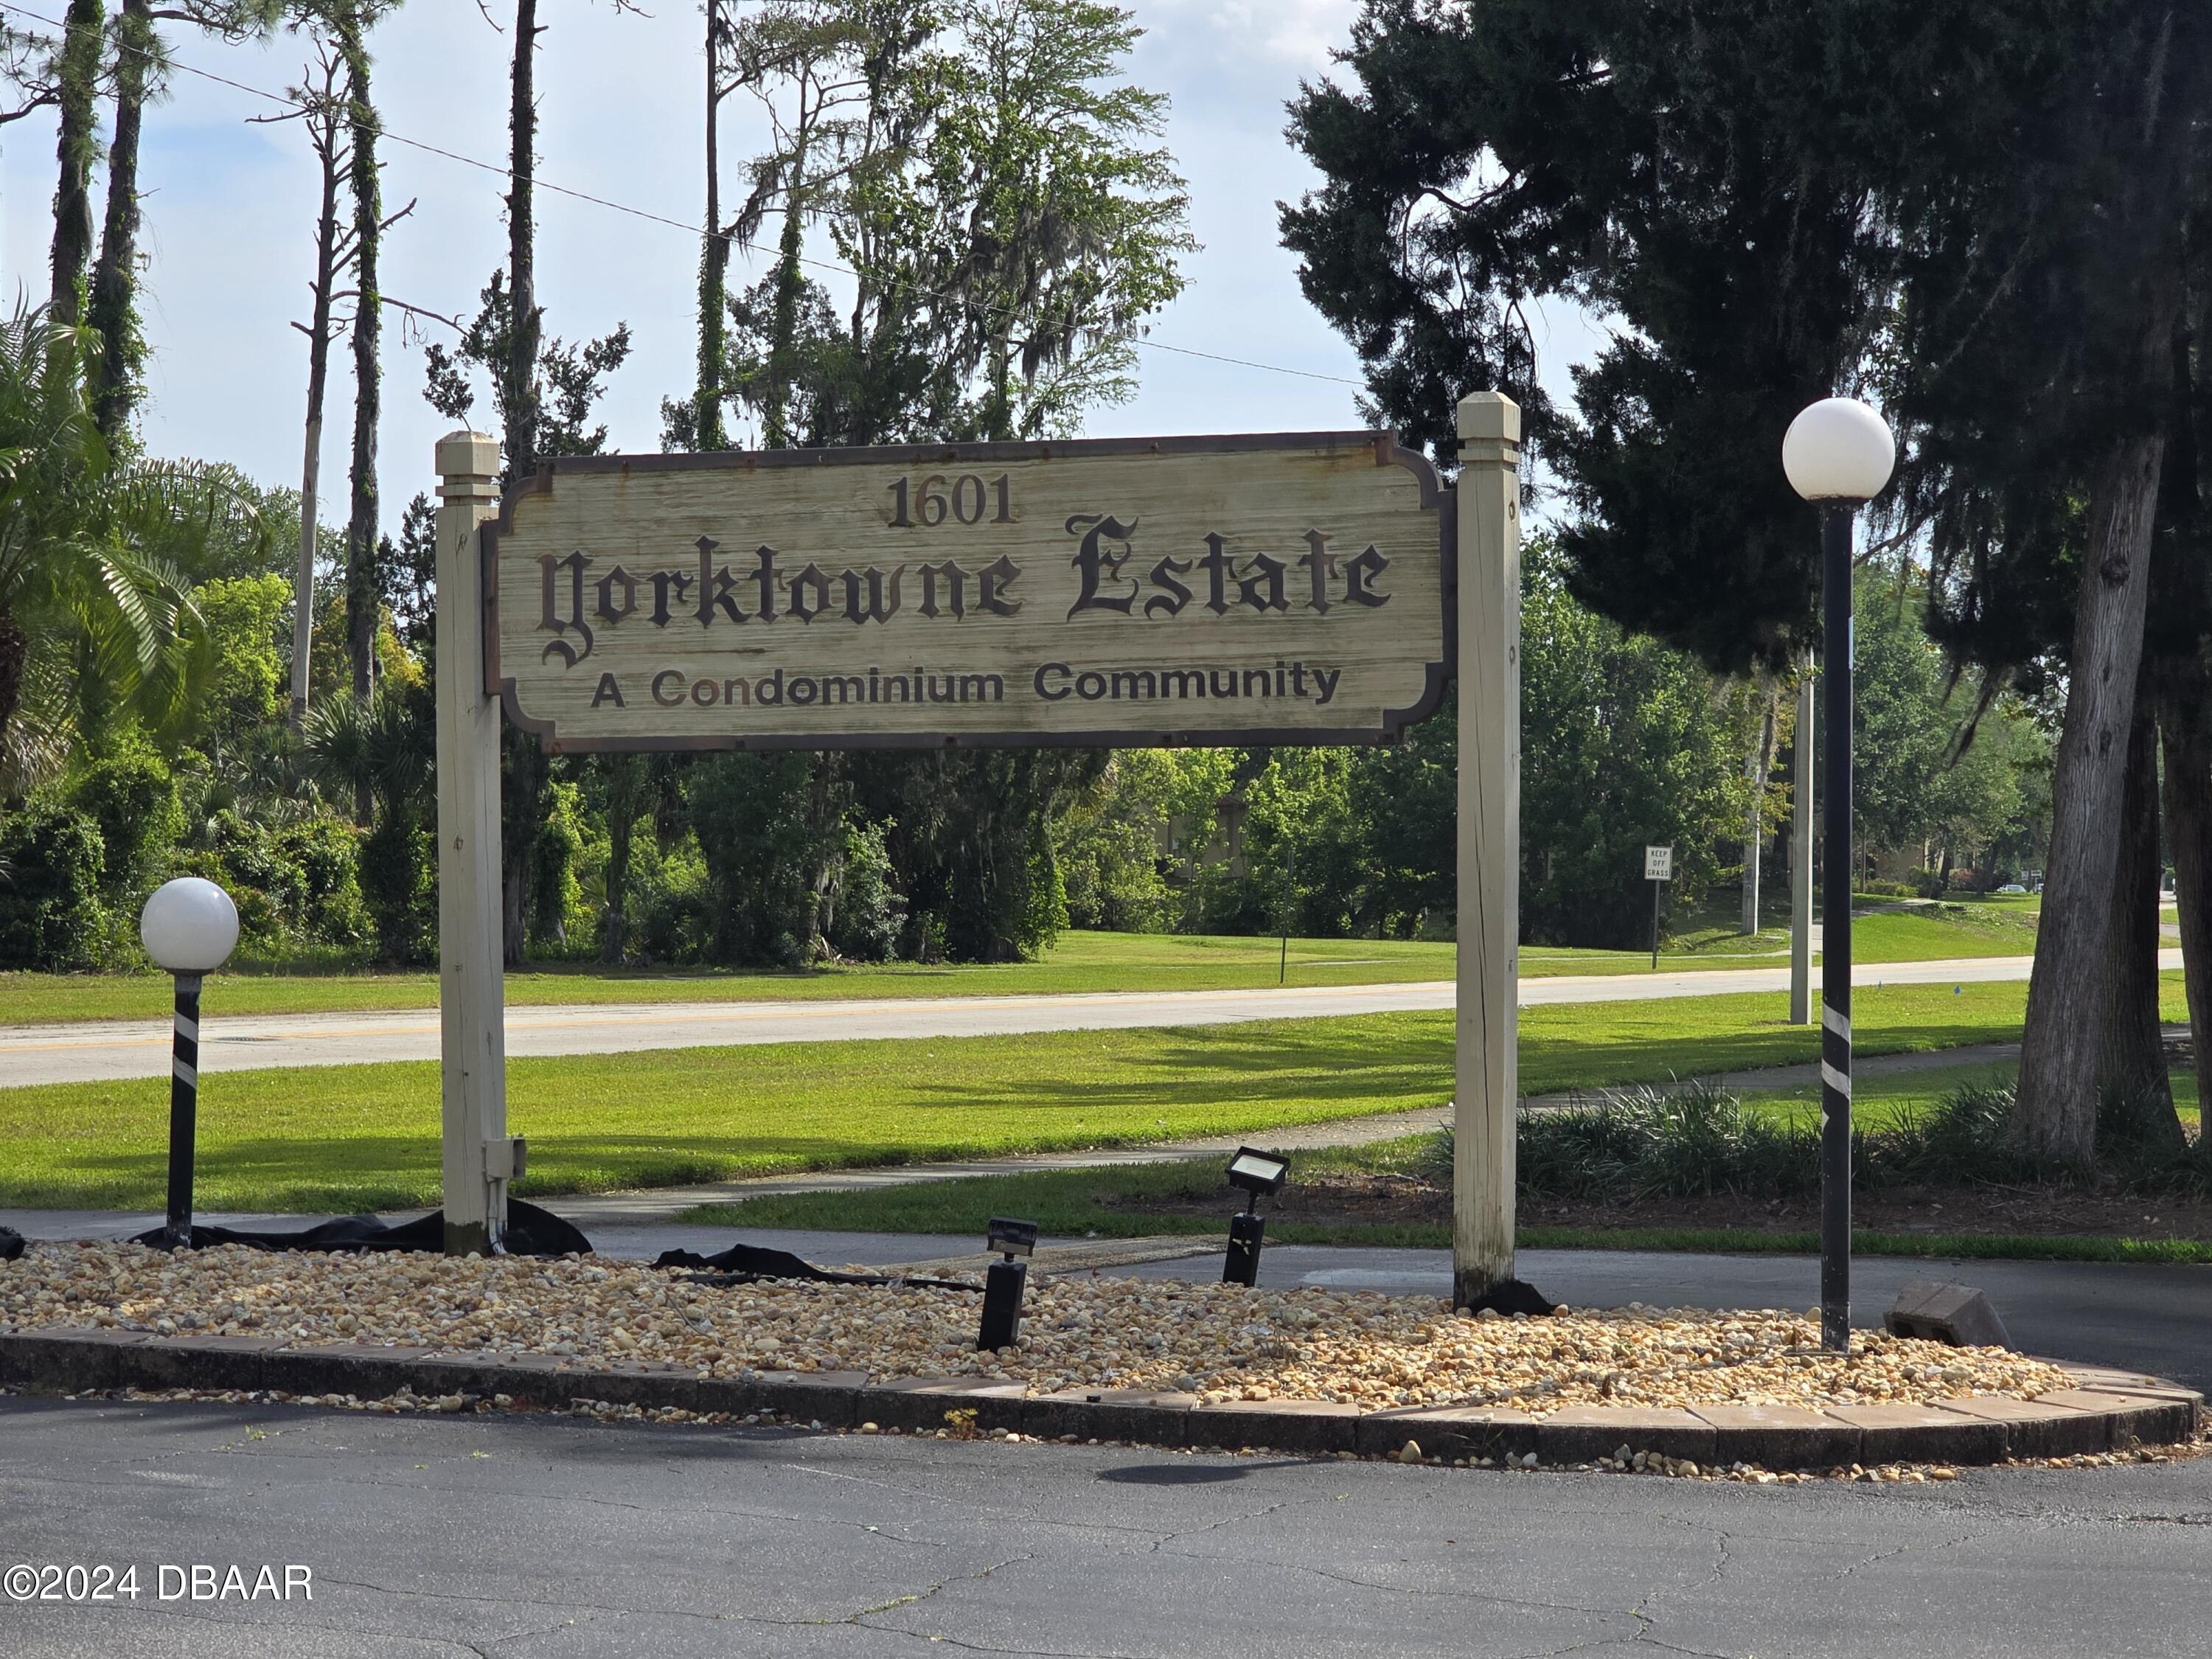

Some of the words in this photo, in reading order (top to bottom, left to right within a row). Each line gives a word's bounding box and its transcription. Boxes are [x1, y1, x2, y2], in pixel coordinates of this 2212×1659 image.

[887, 473, 1020, 528] 1601
[1065, 513, 1392, 623] Estate
[590, 672, 627, 708] A
[651, 668, 1004, 708] Condominium
[1033, 661, 1341, 705] Community
